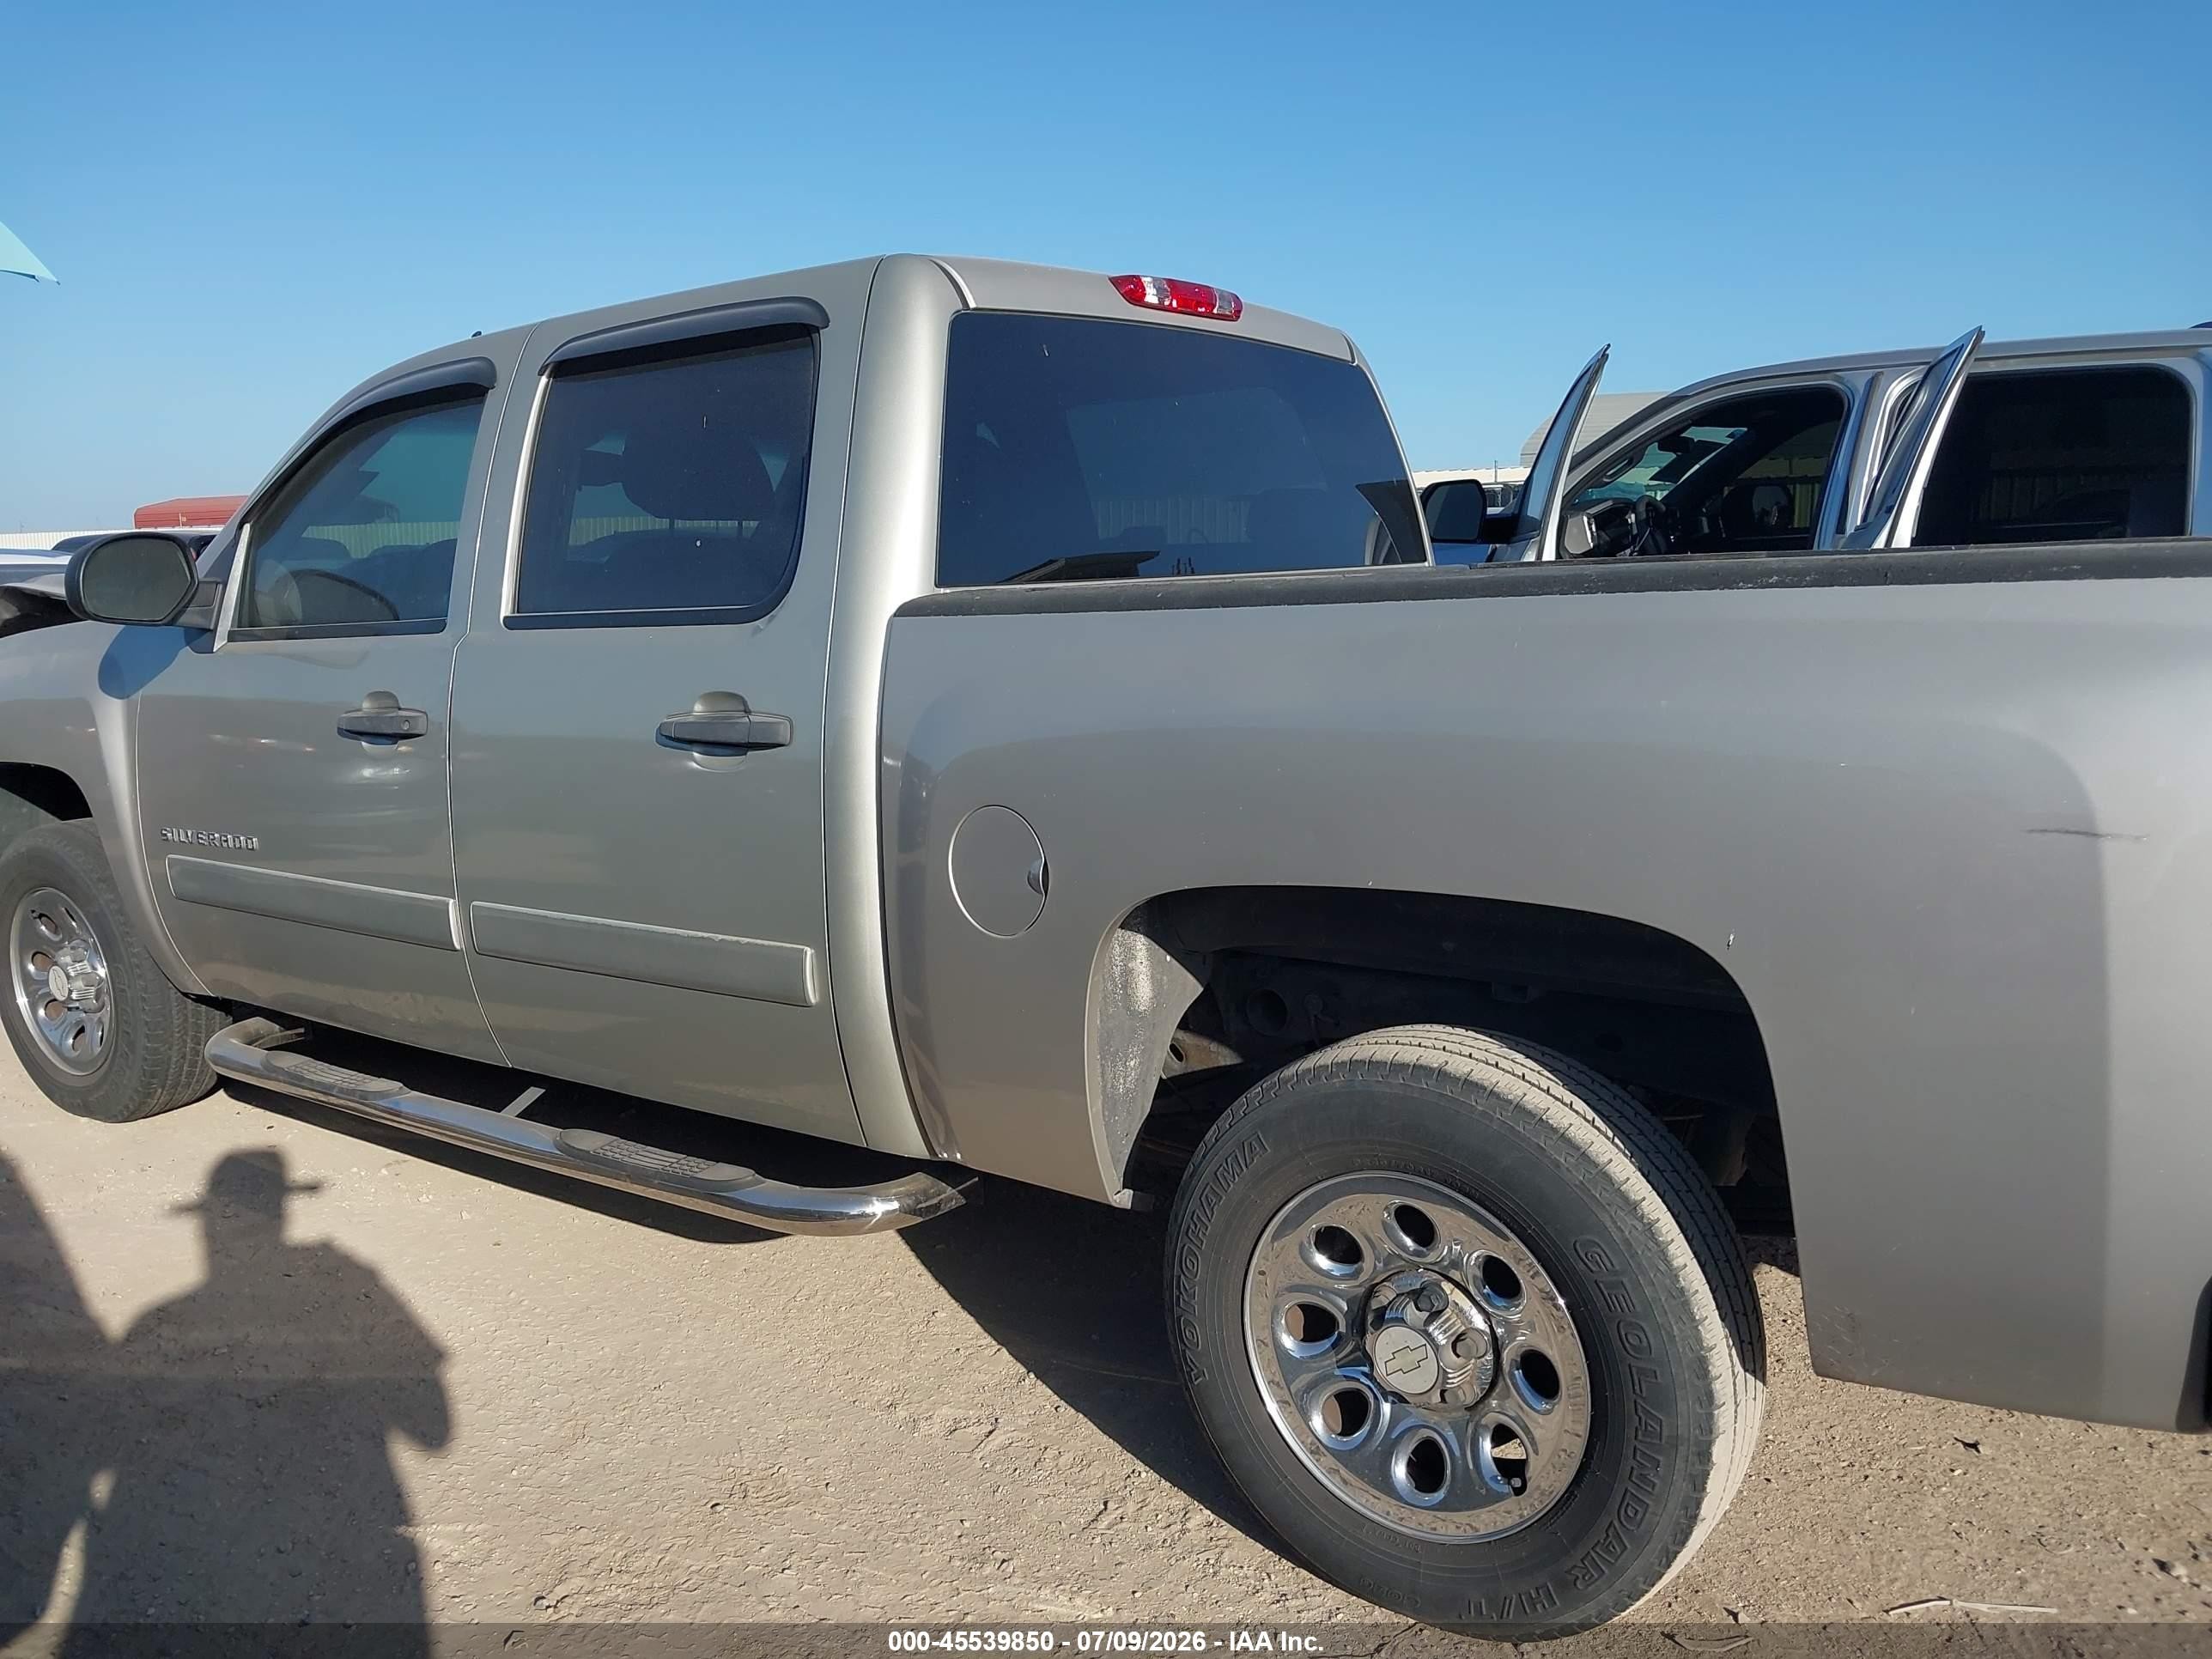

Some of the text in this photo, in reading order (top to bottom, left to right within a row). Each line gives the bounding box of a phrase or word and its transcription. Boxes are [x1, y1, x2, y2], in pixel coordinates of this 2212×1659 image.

[160, 826, 258, 851] SILVERADO
[1179, 1132, 1271, 1384] YOKOHAMA
[1565, 1235, 1663, 1589] GEOLANDAR
